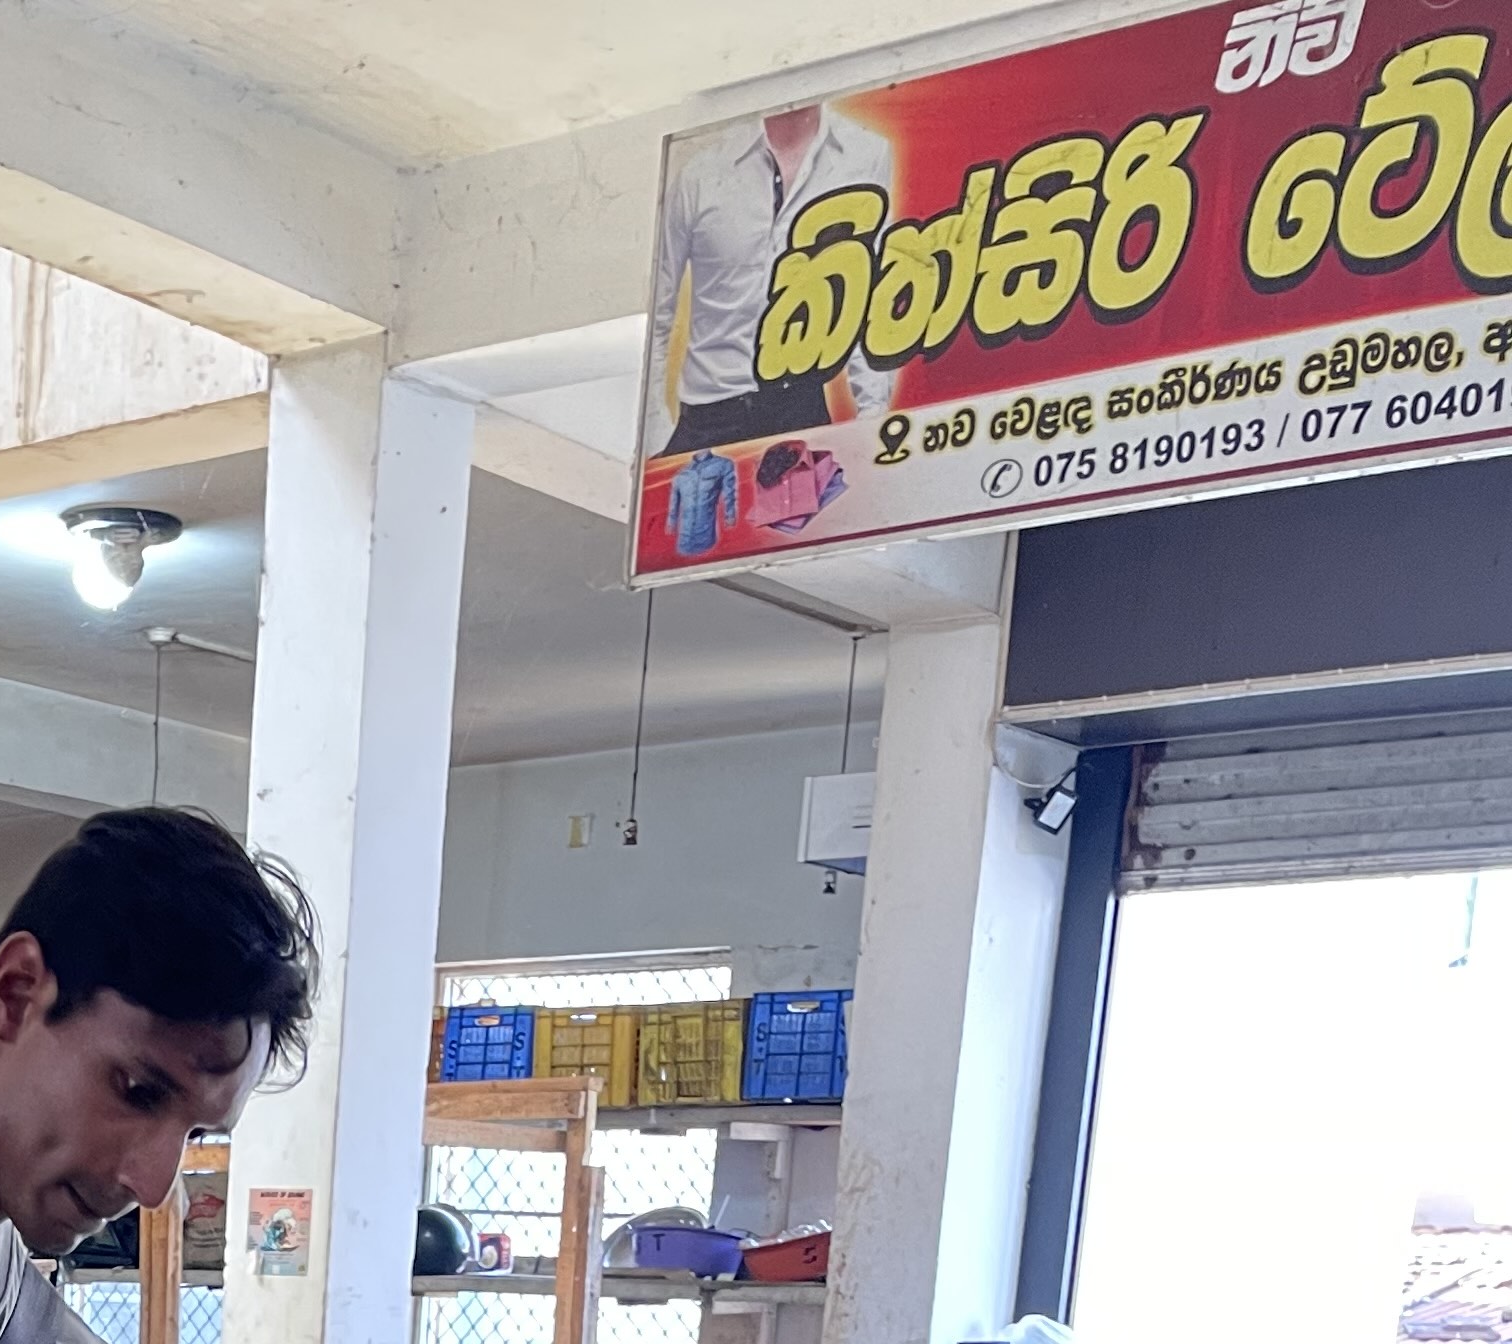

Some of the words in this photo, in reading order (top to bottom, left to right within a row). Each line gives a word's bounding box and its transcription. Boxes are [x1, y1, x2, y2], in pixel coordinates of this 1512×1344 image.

[755, 112, 1206, 385] කිත්සිරි
[922, 407, 977, 452] නව
[1107, 360, 1284, 420] සංකීර්ණය
[1034, 447, 1097, 487] 075
[1109, 418, 1265, 475] 8190193
[1276, 412, 1290, 448] /
[1301, 401, 1373, 443] 077
[1385, 377, 1512, 429] 60401
